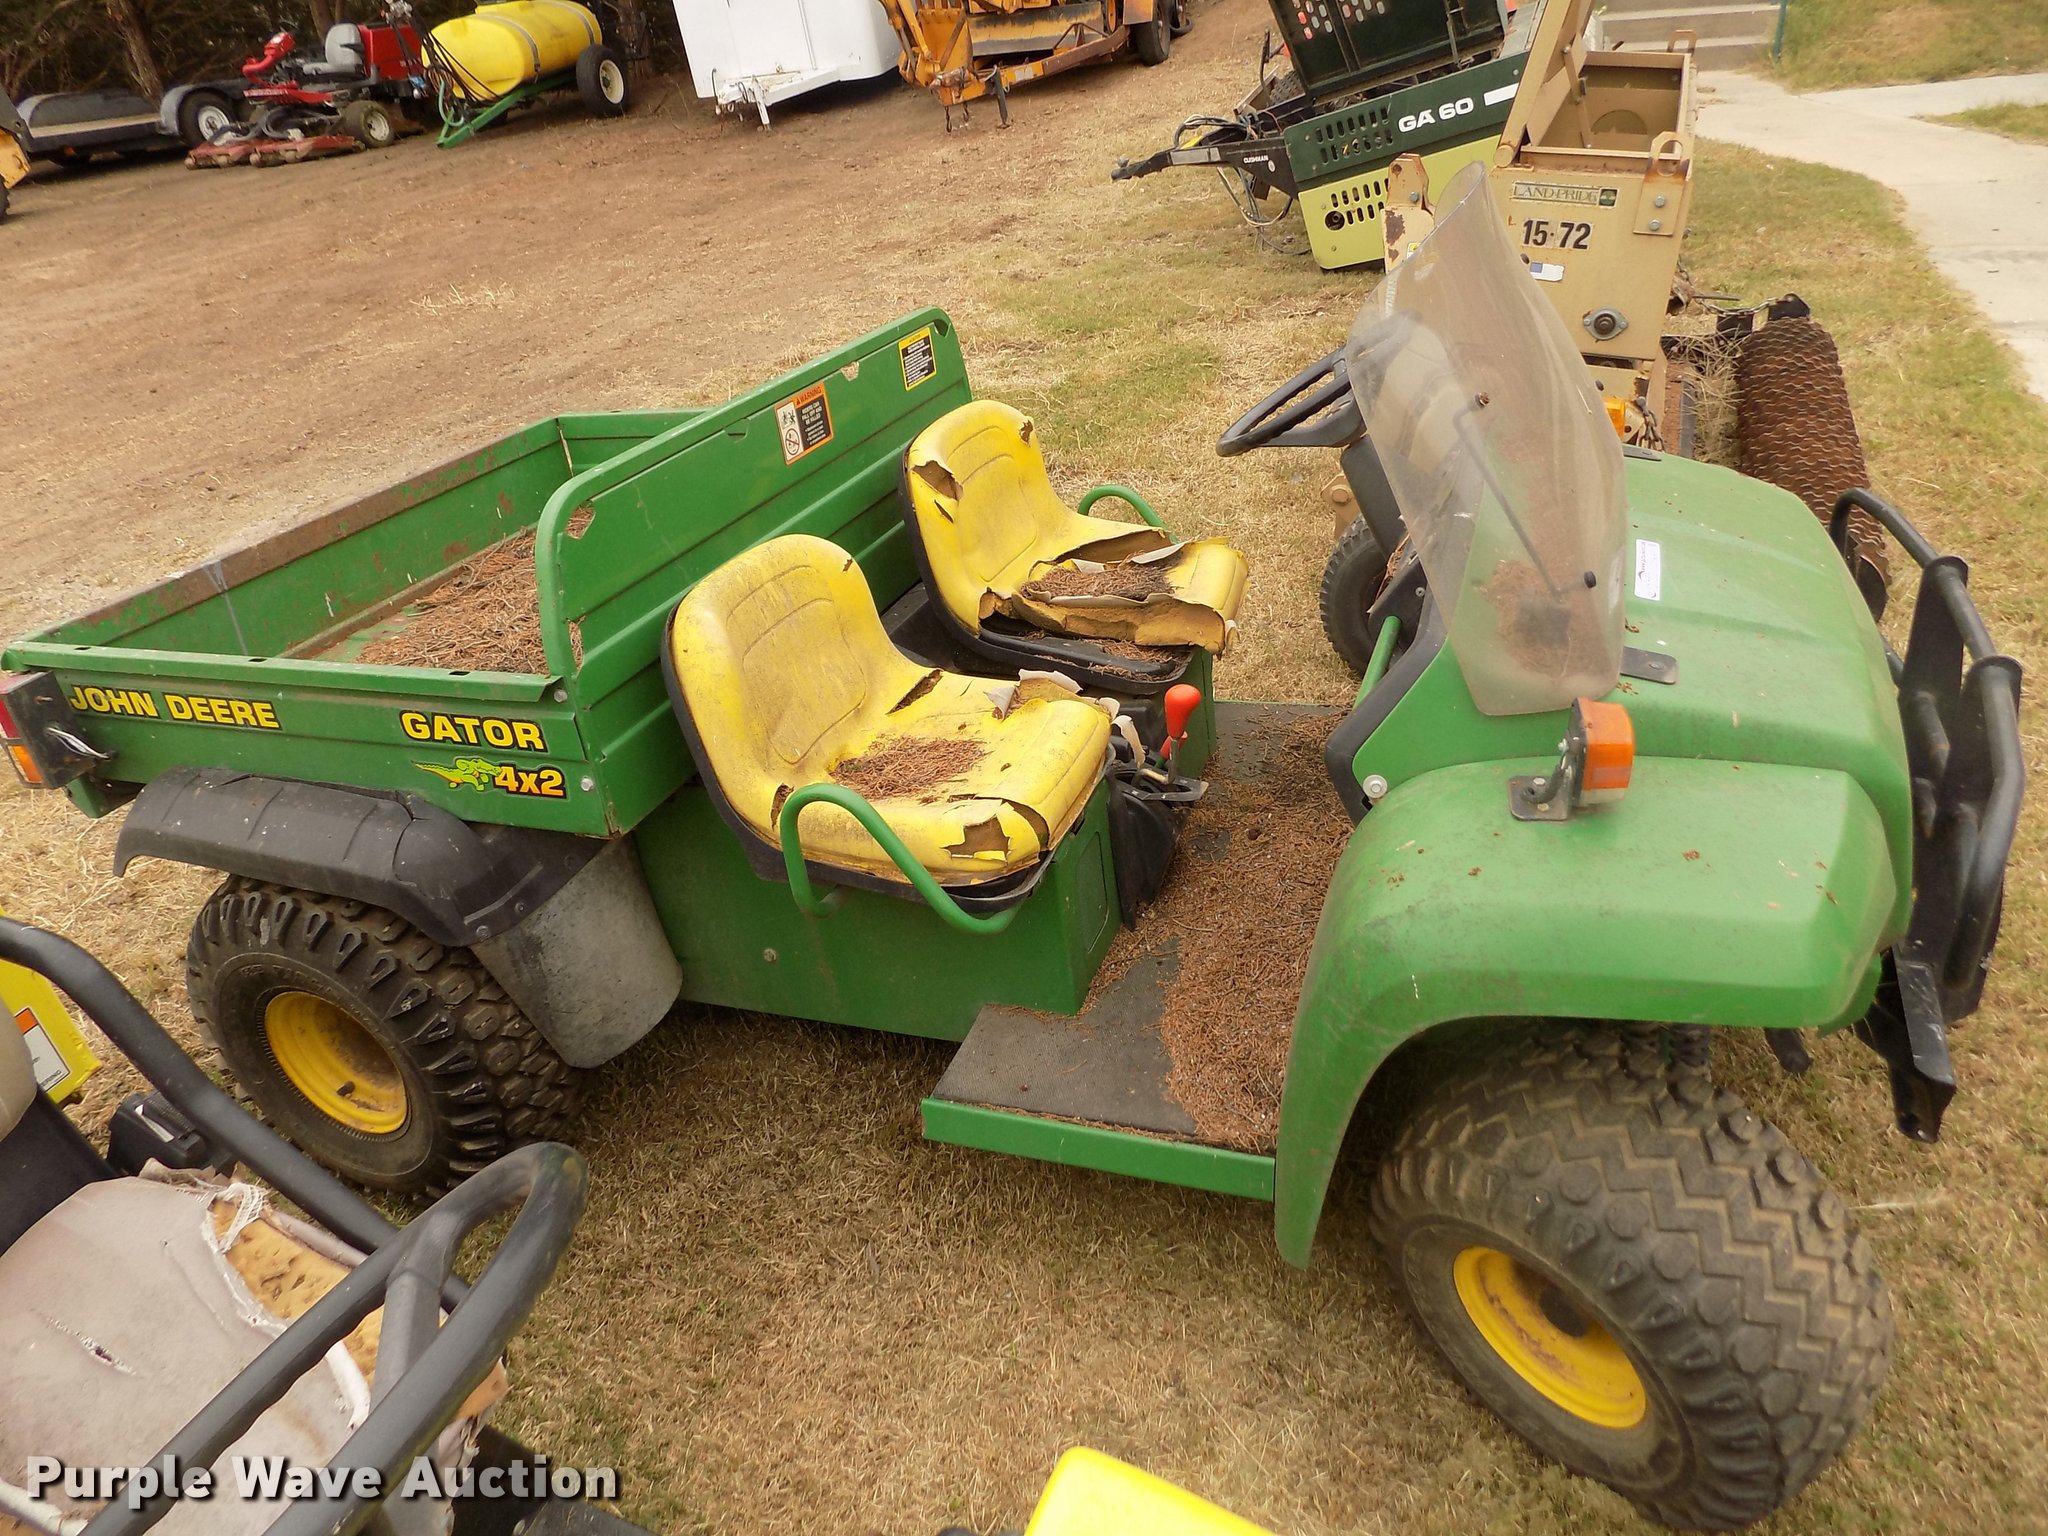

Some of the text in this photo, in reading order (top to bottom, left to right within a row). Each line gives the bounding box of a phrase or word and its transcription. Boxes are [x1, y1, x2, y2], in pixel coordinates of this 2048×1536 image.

[1398, 97, 1474, 133] GA 60
[800, 386, 822, 404] WARNING
[70, 686, 280, 728] JOHN DEERE
[400, 711, 545, 750] GATOR
[494, 765, 565, 797] 4x2
